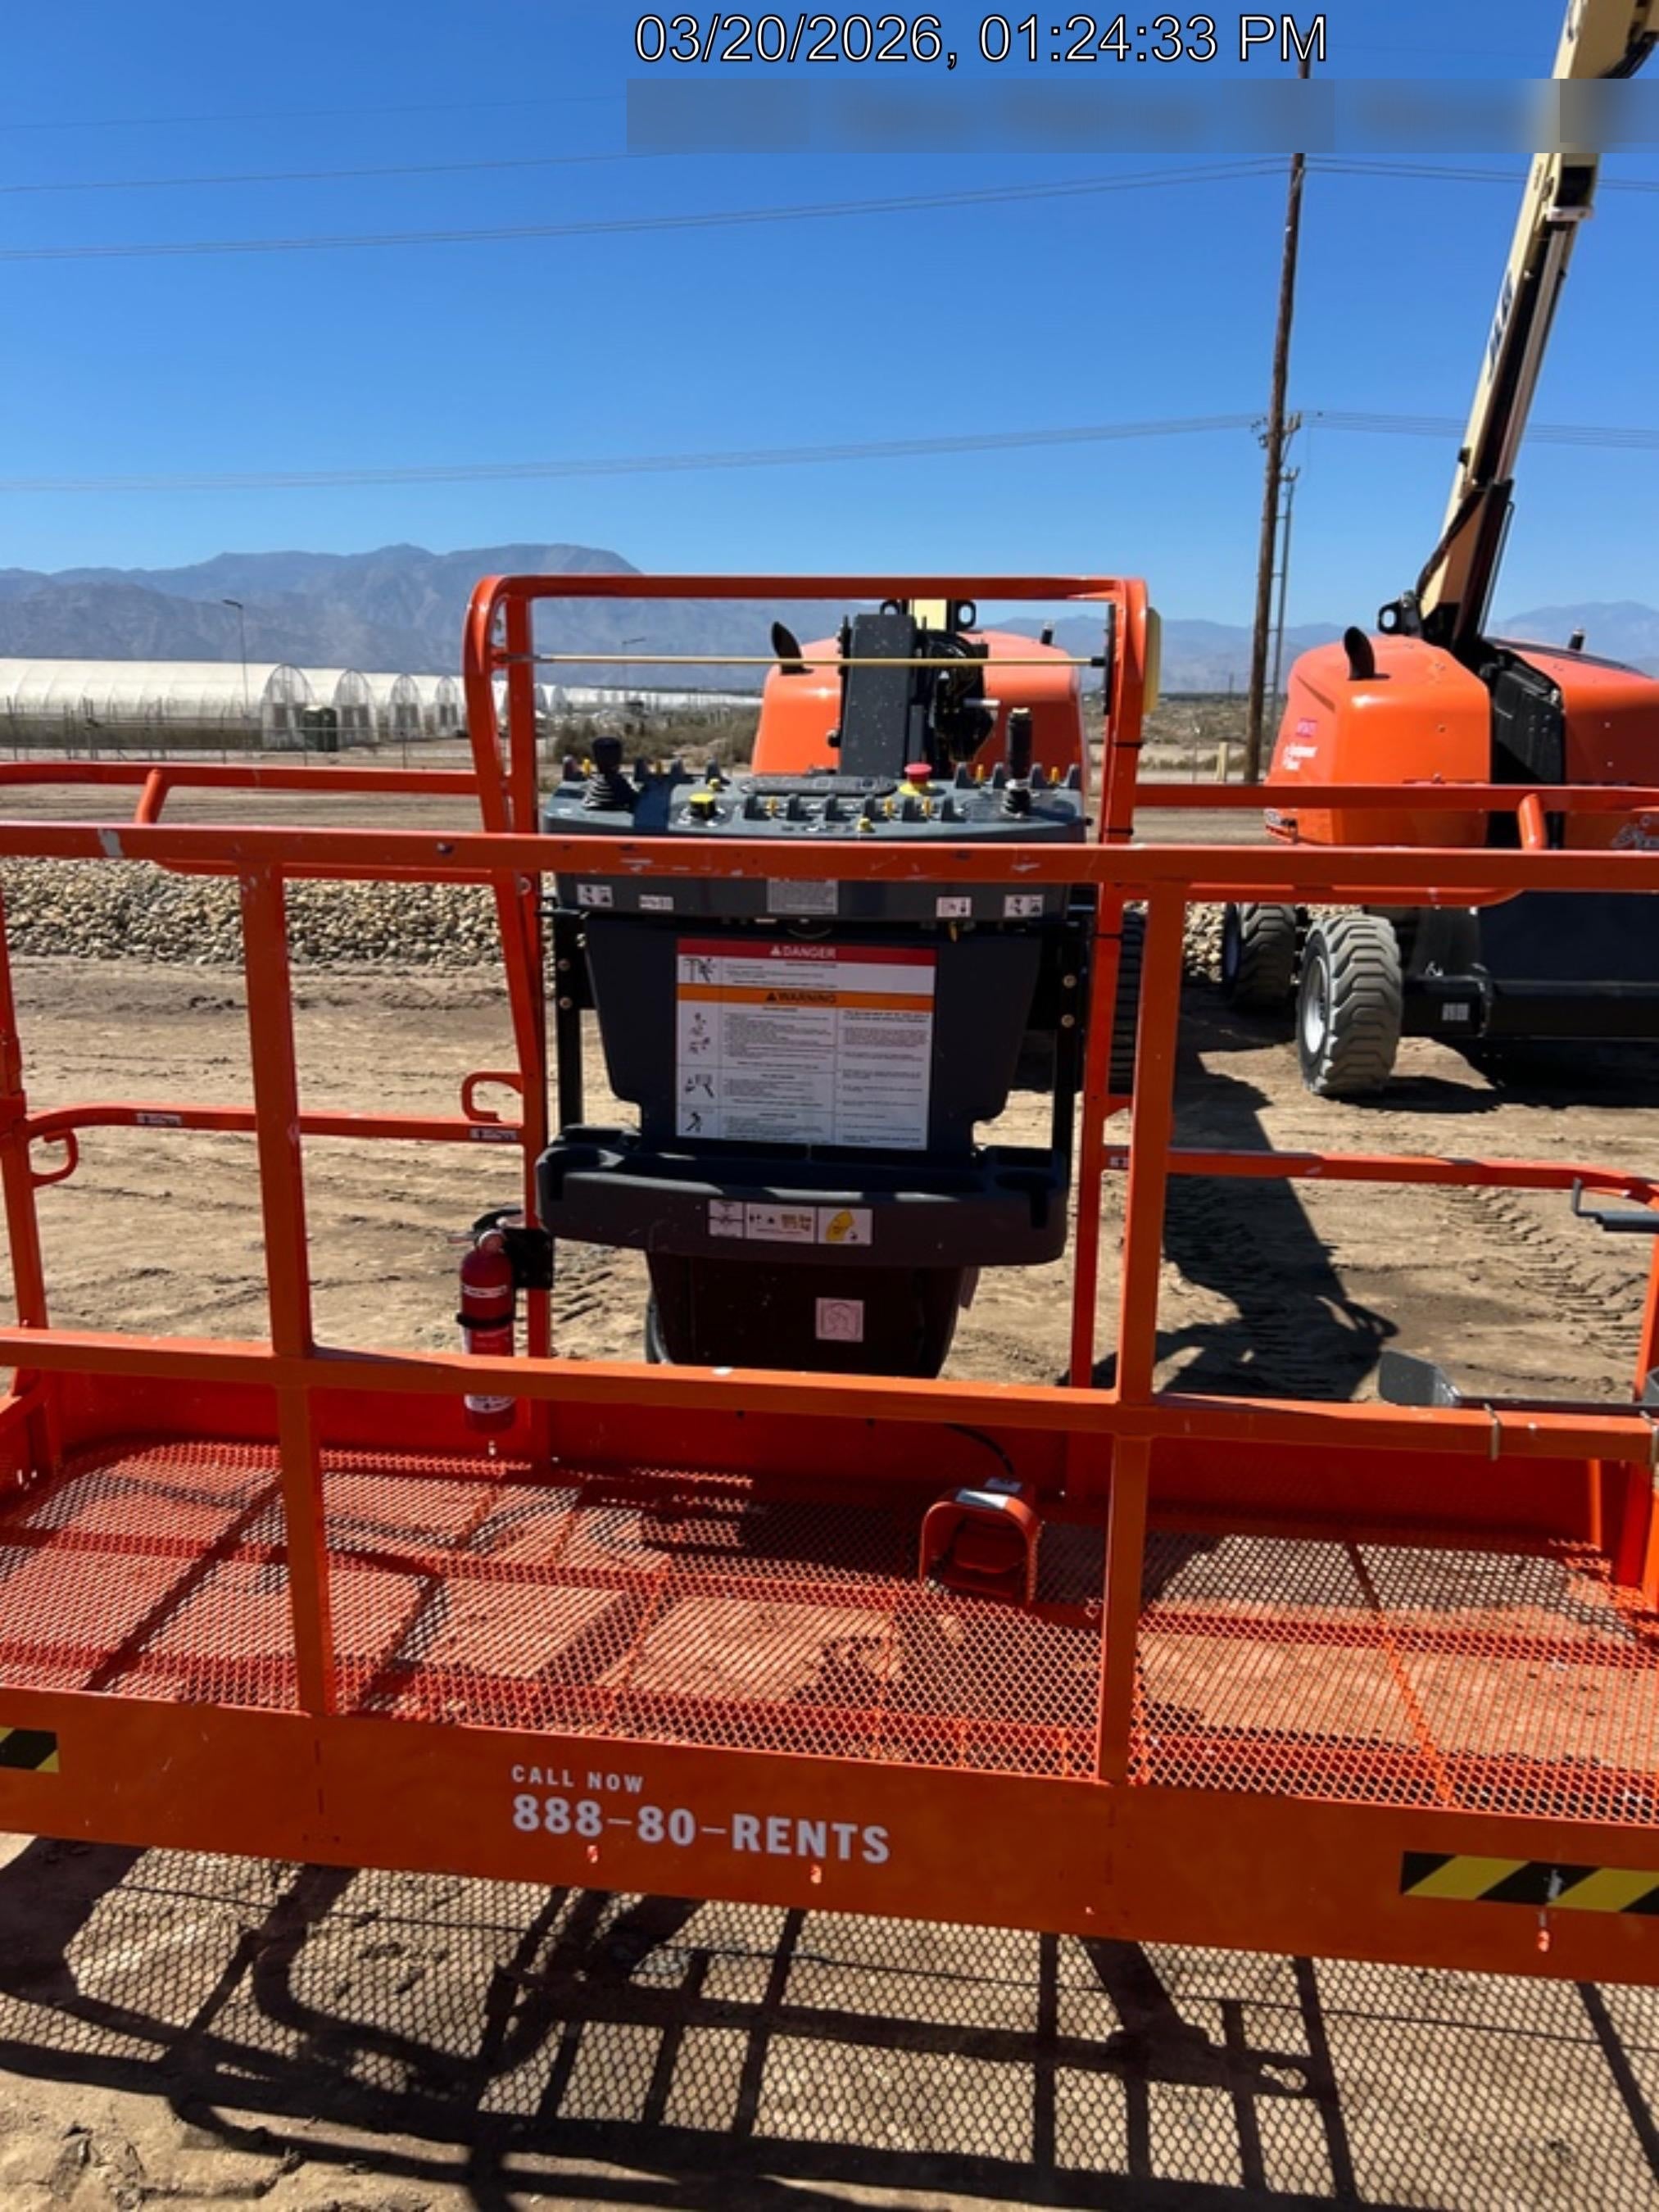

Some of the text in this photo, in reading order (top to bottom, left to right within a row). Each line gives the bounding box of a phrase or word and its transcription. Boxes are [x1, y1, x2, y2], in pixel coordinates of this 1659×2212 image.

[782, 945, 836, 959] DANGER
[777, 991, 836, 1004] WARNING
[511, 1764, 644, 1793] CALL NOW
[512, 1793, 890, 1864] 888-80-RENTS
